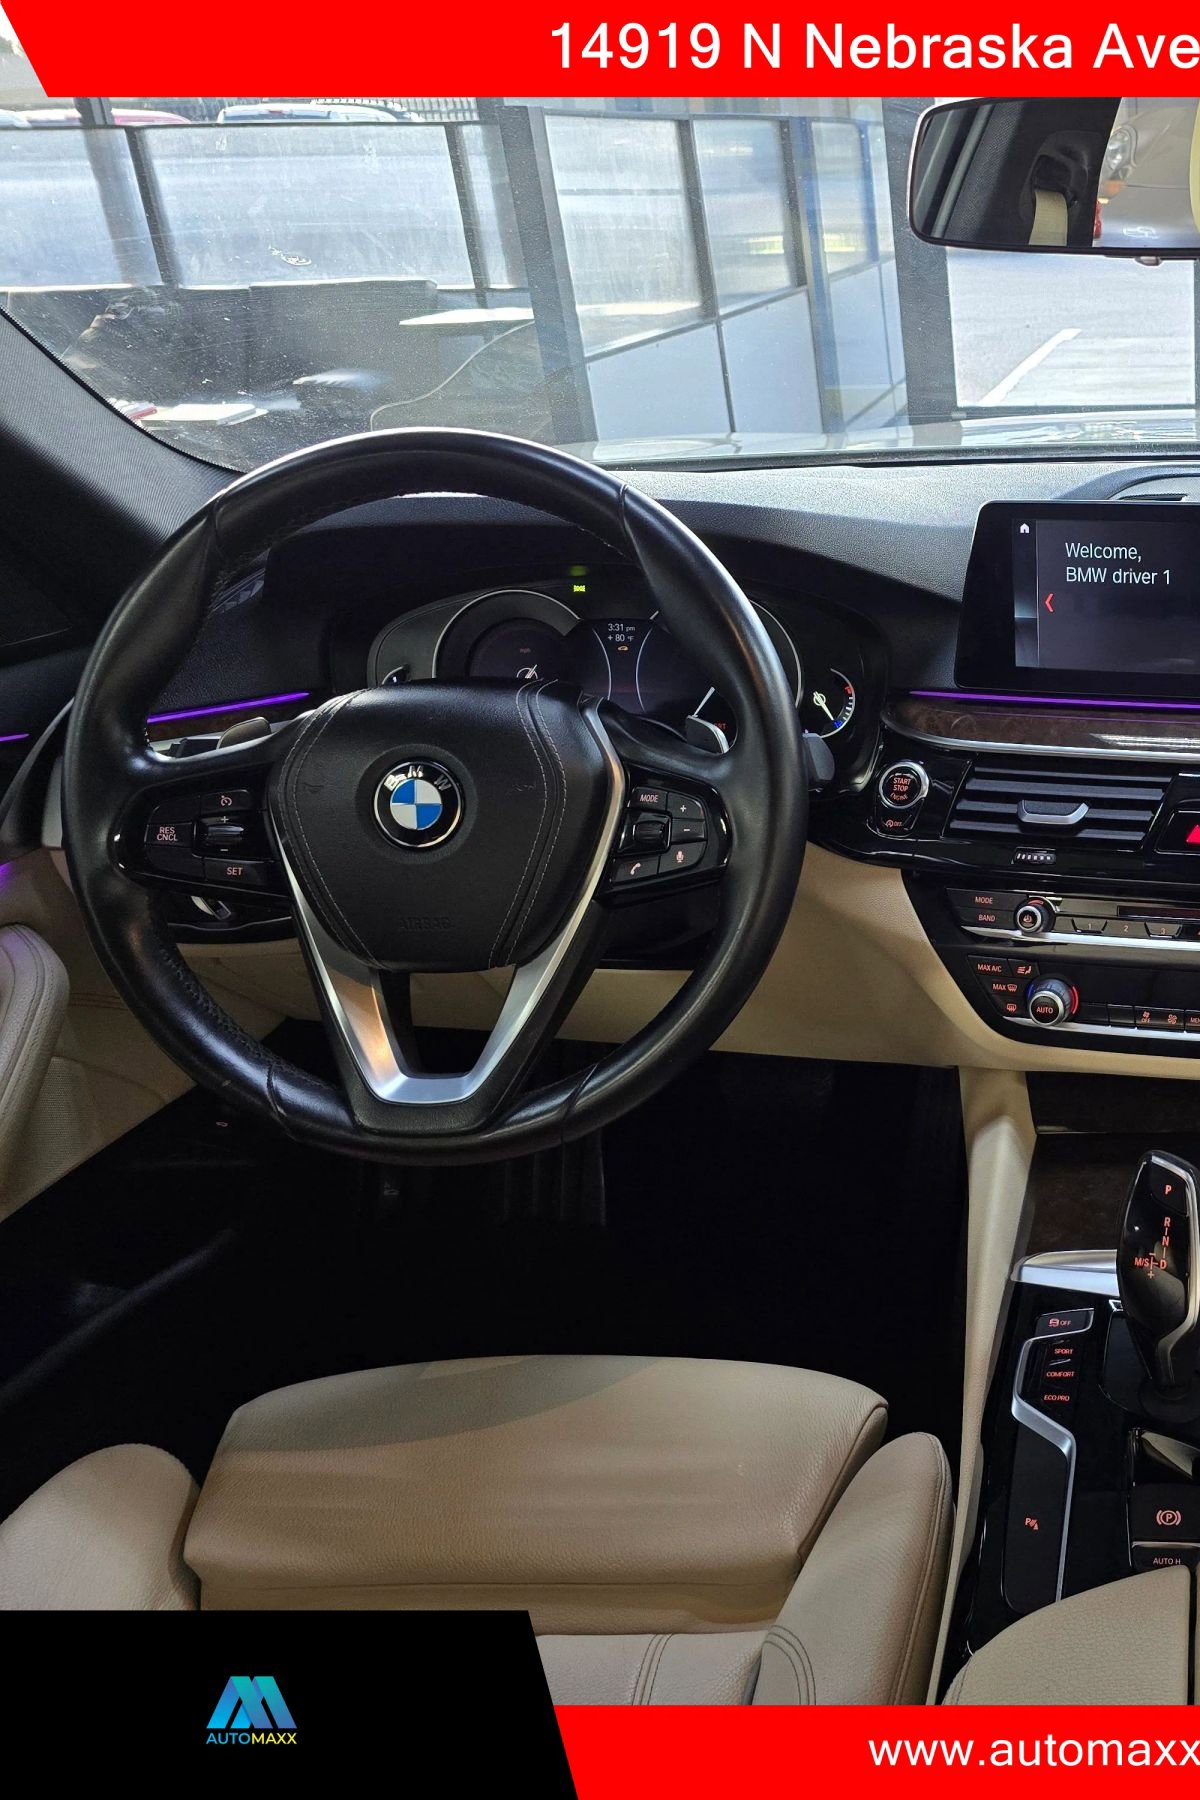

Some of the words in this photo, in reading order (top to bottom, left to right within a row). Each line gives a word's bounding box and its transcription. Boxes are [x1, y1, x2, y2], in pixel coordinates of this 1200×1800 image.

[1064, 541, 1142, 562] Welcome,
[1066, 566, 1107, 583] BMW
[1112, 567, 1159, 585] driver
[1162, 569, 1171, 585] 1
[607, 623, 624, 632] 3:31
[615, 634, 625, 642] 80
[384, 764, 452, 792] BMW
[893, 778, 911, 786] START
[639, 794, 659, 803] MODE
[159, 826, 176, 834] RES
[156, 833, 178, 841] CNCL
[226, 867, 244, 875] SET
[975, 896, 993, 905] MODE
[978, 914, 996, 923] BAND
[977, 963, 991, 972] MAX
[991, 964, 1002, 973] A/C
[993, 983, 1006, 991] MAX
[1036, 1006, 1054, 1014] AUTO
[1164, 1184, 1172, 1195] P
[1163, 1216, 1171, 1227] R
[1161, 1236, 1169, 1247] N
[1159, 1259, 1167, 1270] D
[1153, 1557, 1173, 1565] AUTO
